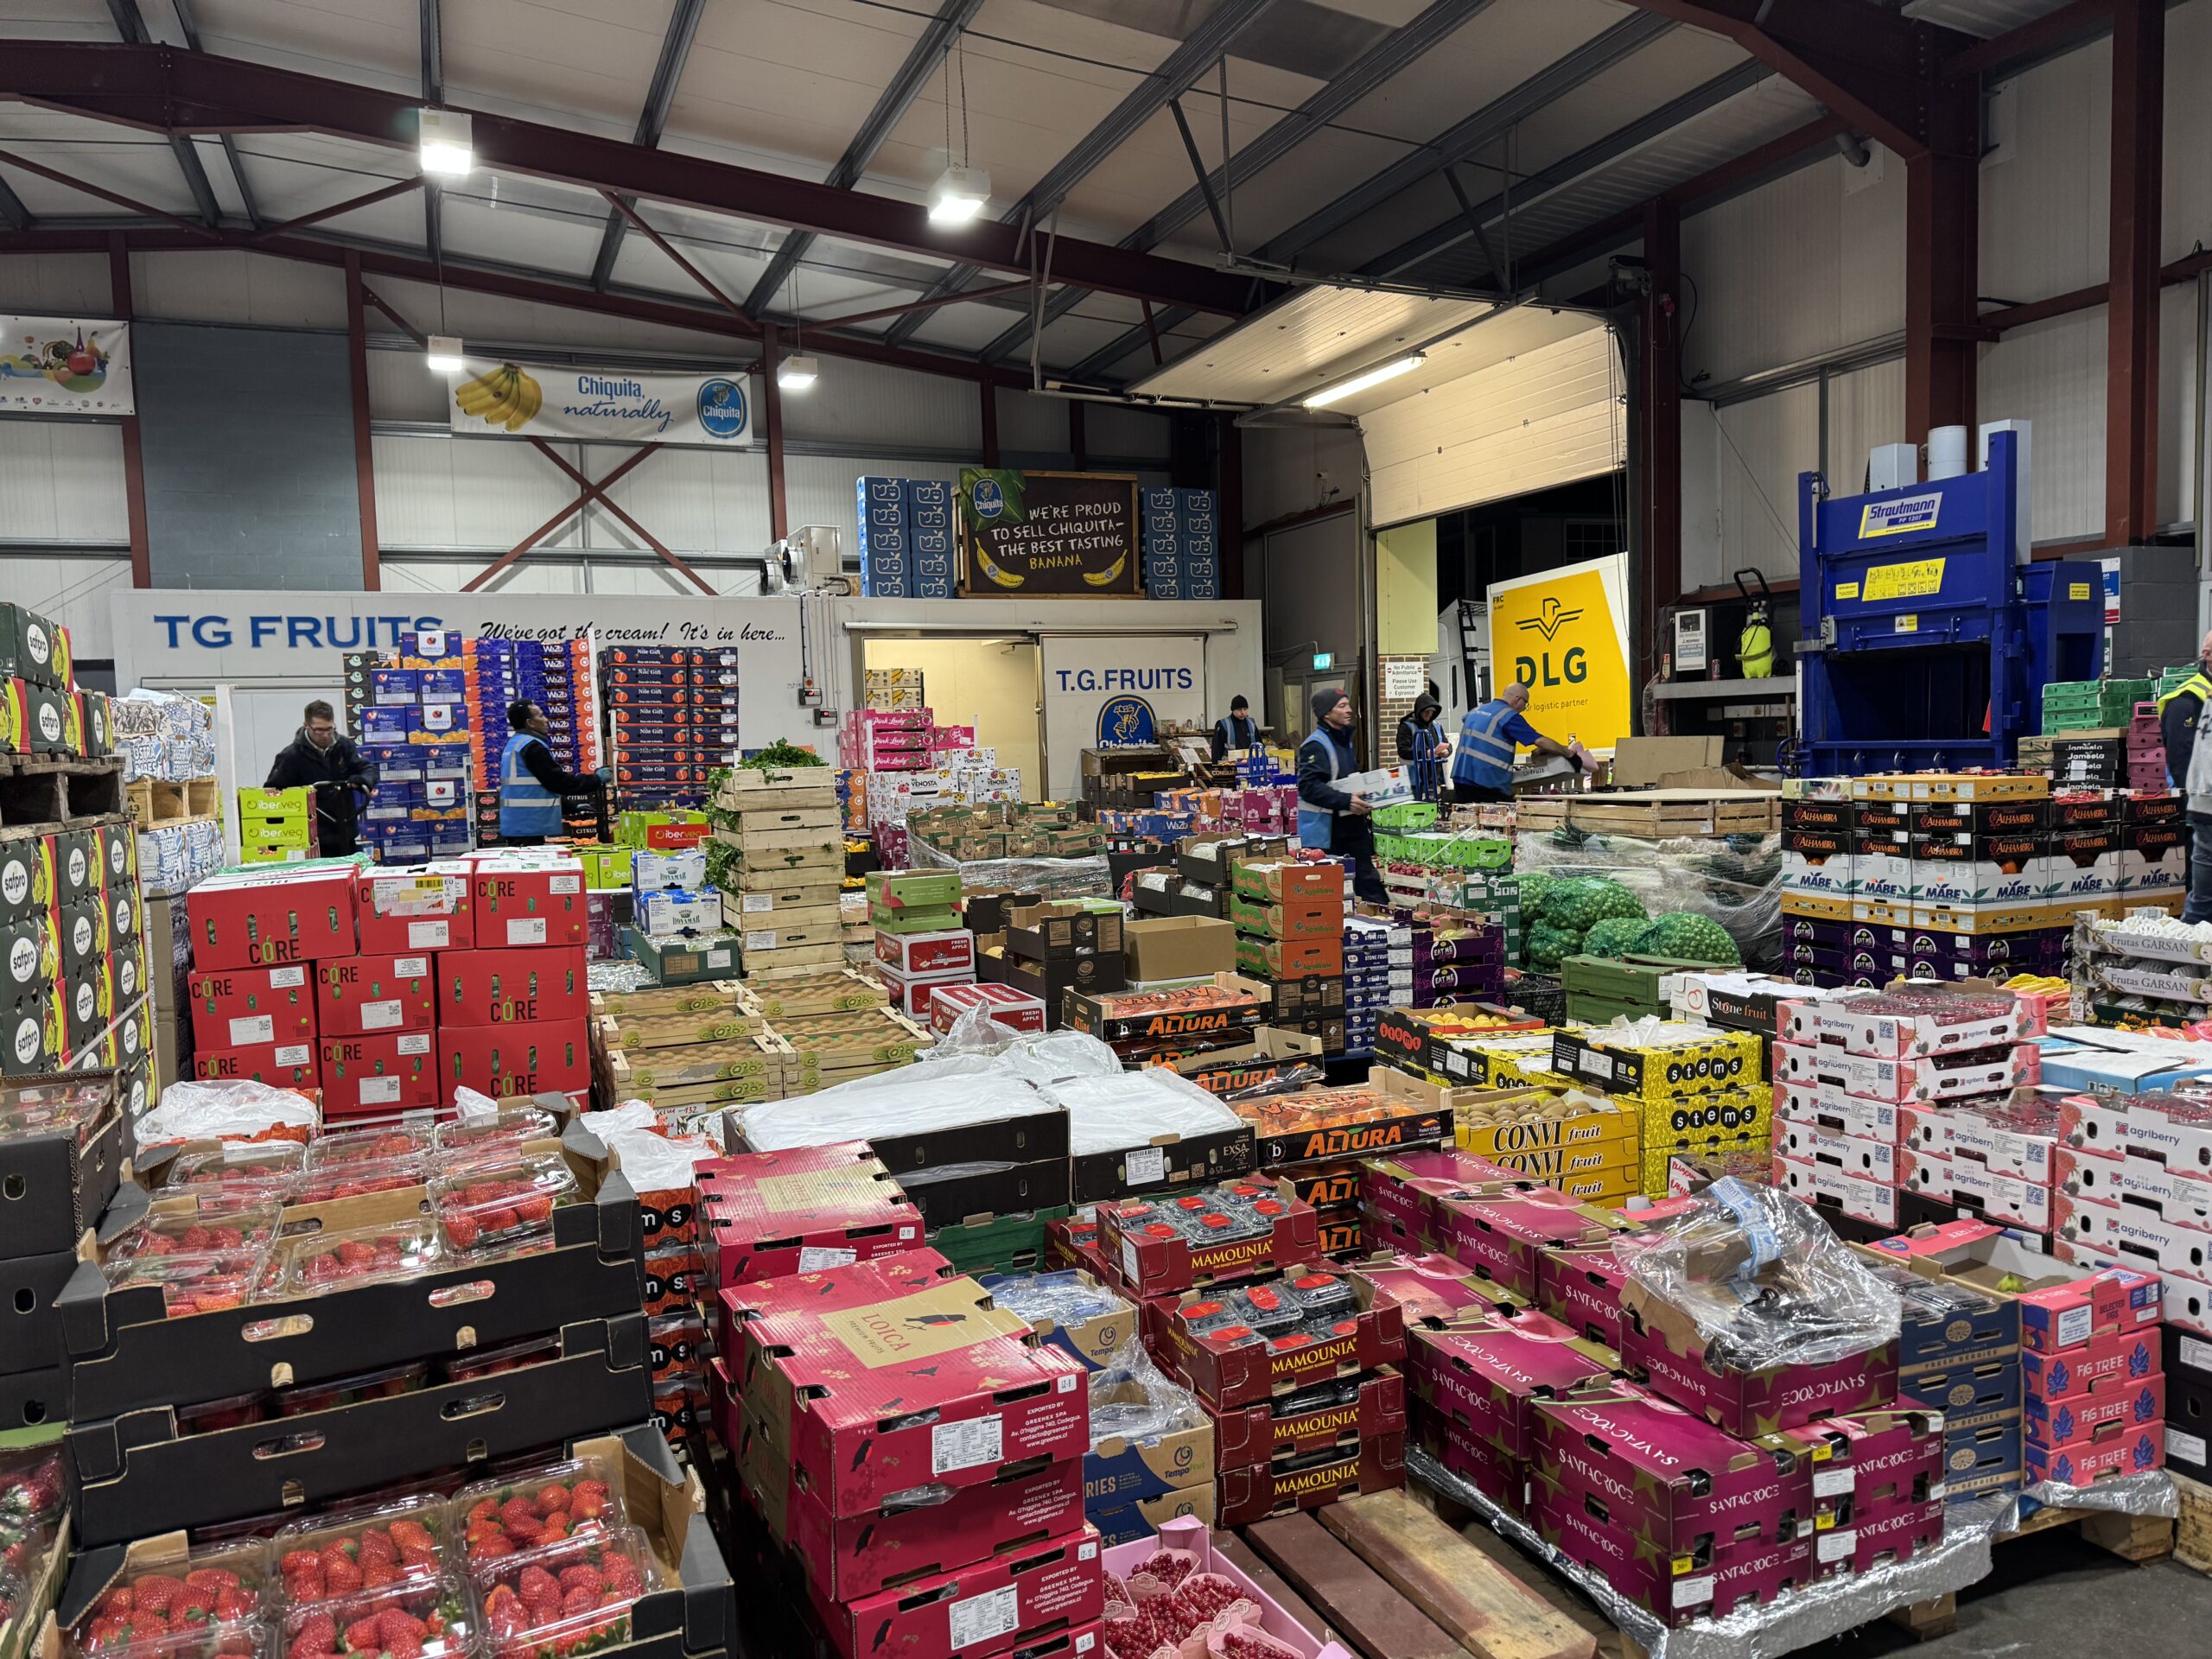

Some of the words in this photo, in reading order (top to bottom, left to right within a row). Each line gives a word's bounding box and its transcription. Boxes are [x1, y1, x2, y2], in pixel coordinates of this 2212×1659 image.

[578, 376, 645, 400] Chiquita,
[563, 398, 674, 432] naturally
[702, 404, 741, 420] Chiquita
[975, 499, 1004, 512] Chiquita
[1029, 505, 1070, 520] WE'RE
[1075, 502, 1122, 518] PROUD
[1869, 499, 1936, 519] Strautmann
[991, 527, 1010, 541] TO
[1014, 525, 1046, 539] SELL
[998, 542, 1027, 557] THE
[1031, 538, 1064, 554] BEST
[1068, 534, 1124, 551] TASTING
[1029, 553, 1083, 570] BANANA
[1492, 594, 1504, 604] FRC
[154, 614, 234, 648] TG
[480, 621, 533, 640] We've
[537, 624, 567, 642] got
[575, 620, 602, 640] the
[606, 621, 671, 641] cream!
[680, 621, 710, 641] It's
[717, 623, 735, 641] in
[649, 648, 661, 657] Gift
[1516, 646, 1588, 690] DLG
[1056, 668, 1192, 691] T.G.FRUITS
[1534, 700, 1560, 712] logistic
[1560, 698, 1588, 710] partner
[872, 717, 889, 726] Pink
[889, 717, 906, 726] Lady
[651, 728, 664, 736] Gift
[873, 737, 890, 746] Pink
[890, 737, 908, 746] Lady
[2067, 752, 2105, 760] Jameela
[258, 798, 302, 811] iberveg
[1801, 811, 1838, 823] ALHAMBRA
[1866, 814, 1900, 824] ALHAMBRA
[1996, 812, 2034, 823] ALHAMBRA
[2070, 809, 2107, 820] ALHAMBRA
[259, 827, 303, 840] iberveg
[1166, 821, 1188, 830] WaZo
[4, 874, 26, 893] safpro
[2111, 935, 2139, 948] Frutas
[2141, 938, 2190, 953] GARSAN
[13, 950, 35, 971] safpro
[2111, 974, 2139, 986] Frutas
[2141, 977, 2189, 992] GARSAN
[1712, 997, 1743, 1015] Stone
[1744, 1004, 1767, 1020] fruit
[1147, 1013, 1228, 1036] ALTURA
[1822, 1018, 1855, 1031] agriberry
[17, 1030, 38, 1051] safpro
[1671, 1058, 1738, 1080] stems
[1196, 1069, 1277, 1092] ALTURA
[1676, 1108, 1751, 1128] stems
[1304, 1126, 1402, 1158] ALTURA
[1494, 1121, 1561, 1152] CONVI
[1568, 1124, 1604, 1144] fruit
[1819, 1135, 1851, 1152] agriberry
[2130, 1125, 2181, 1146] agriberry
[1223, 1143, 1247, 1156] EXSA
[1570, 1153, 1605, 1173] fruit
[2120, 1224, 2171, 1247] agriberry
[1191, 1242, 1273, 1268] MAMOUNIA
[2099, 1299, 2126, 1314] SELECTED
[2106, 1309, 2120, 1319] FIGS
[861, 1313, 912, 1351] LOICA
[1271, 1341, 1357, 1374] MAMOUNIA
[1925, 1358, 1954, 1369] FRESH
[1958, 1349, 1998, 1363] BERRIES
[2076, 1362, 2093, 1376] FIG
[2095, 1356, 2124, 1371] TREE
[1027, 1403, 1056, 1415] EXPORTED
[2081, 1408, 2097, 1422] FIG
[2101, 1401, 2129, 1417] TREE
[1025, 1414, 1054, 1426] GREENEX
[1273, 1409, 1358, 1439] MAMOUNIA
[1020, 1423, 1074, 1442] contacto@greenex.cl
[1026, 1432, 1068, 1447] www.greenex.cl
[1041, 1568, 1069, 1582] EXPORTED
[1039, 1580, 1068, 1592] GREENEX
